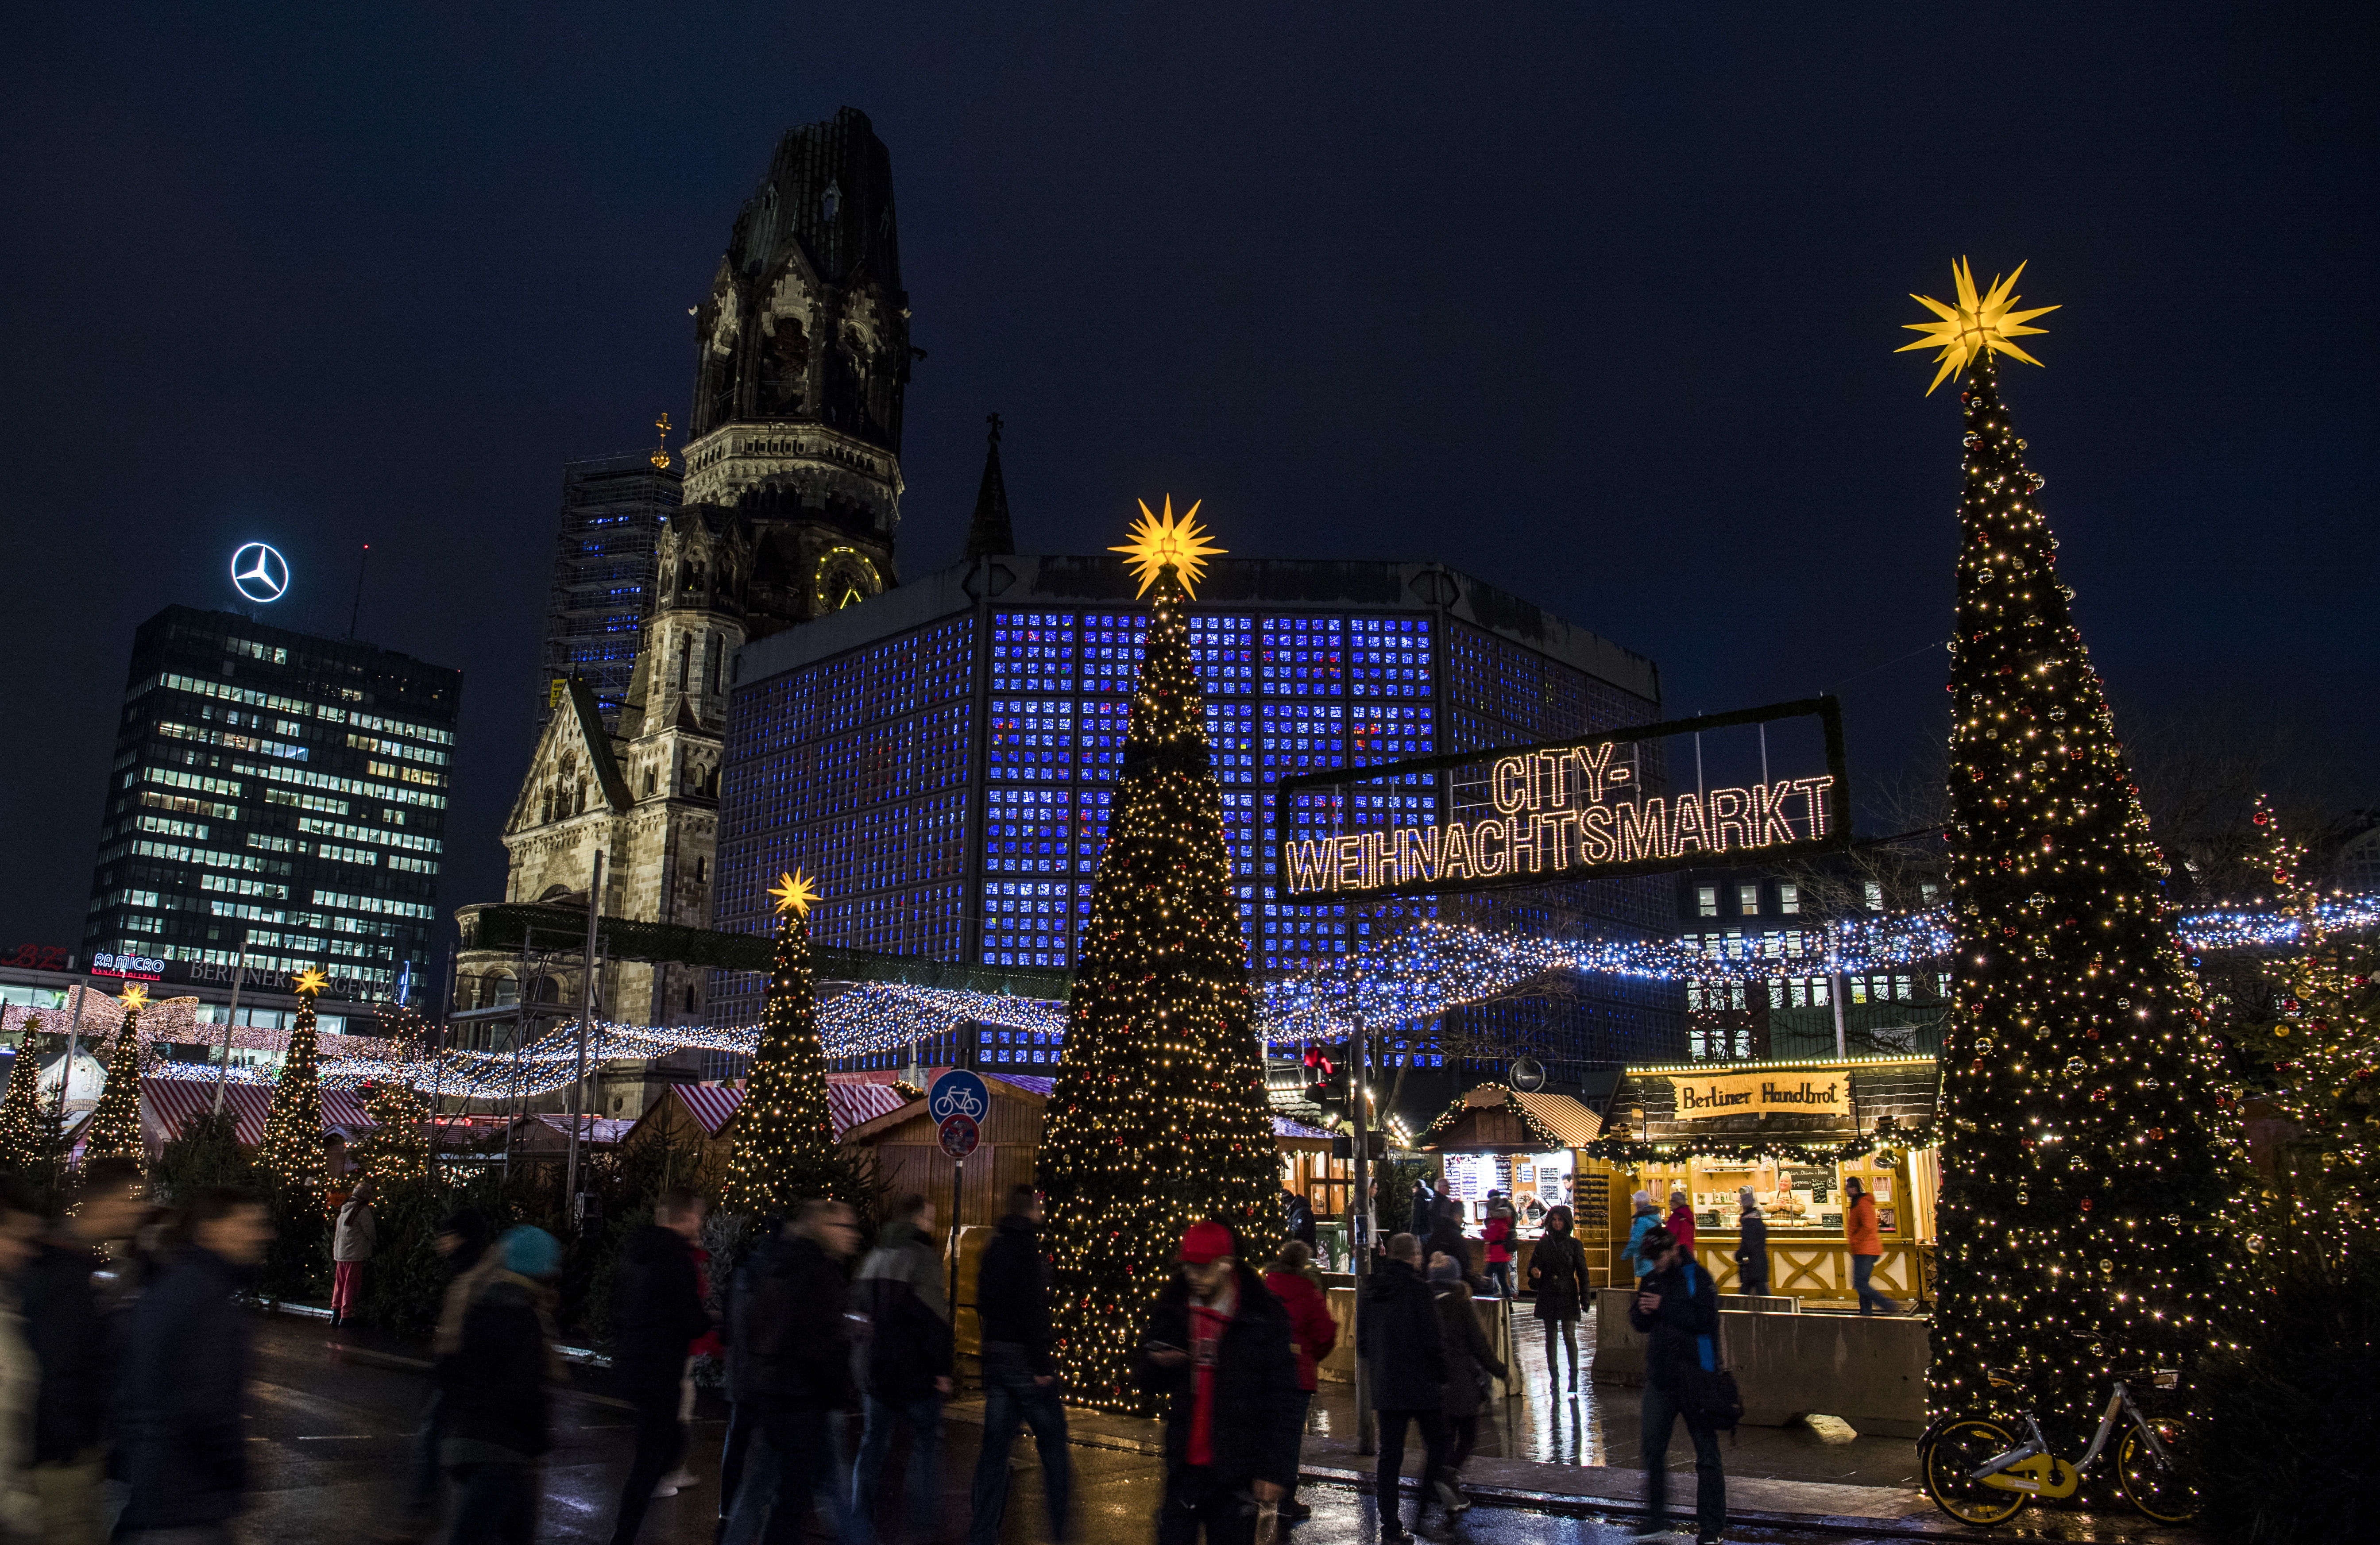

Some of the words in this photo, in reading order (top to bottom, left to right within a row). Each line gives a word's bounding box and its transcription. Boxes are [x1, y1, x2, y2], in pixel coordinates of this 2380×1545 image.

[1492, 741, 1630, 814] CITY-
[1285, 774, 1835, 895] WEIHNACHTSMARKT
[94, 953, 113, 968] RA
[115, 953, 164, 973] MICRO
[189, 958, 286, 989] BERLINER
[1683, 1086, 1752, 1109] Berliner
[1762, 1082, 1838, 1104] Handbrot
